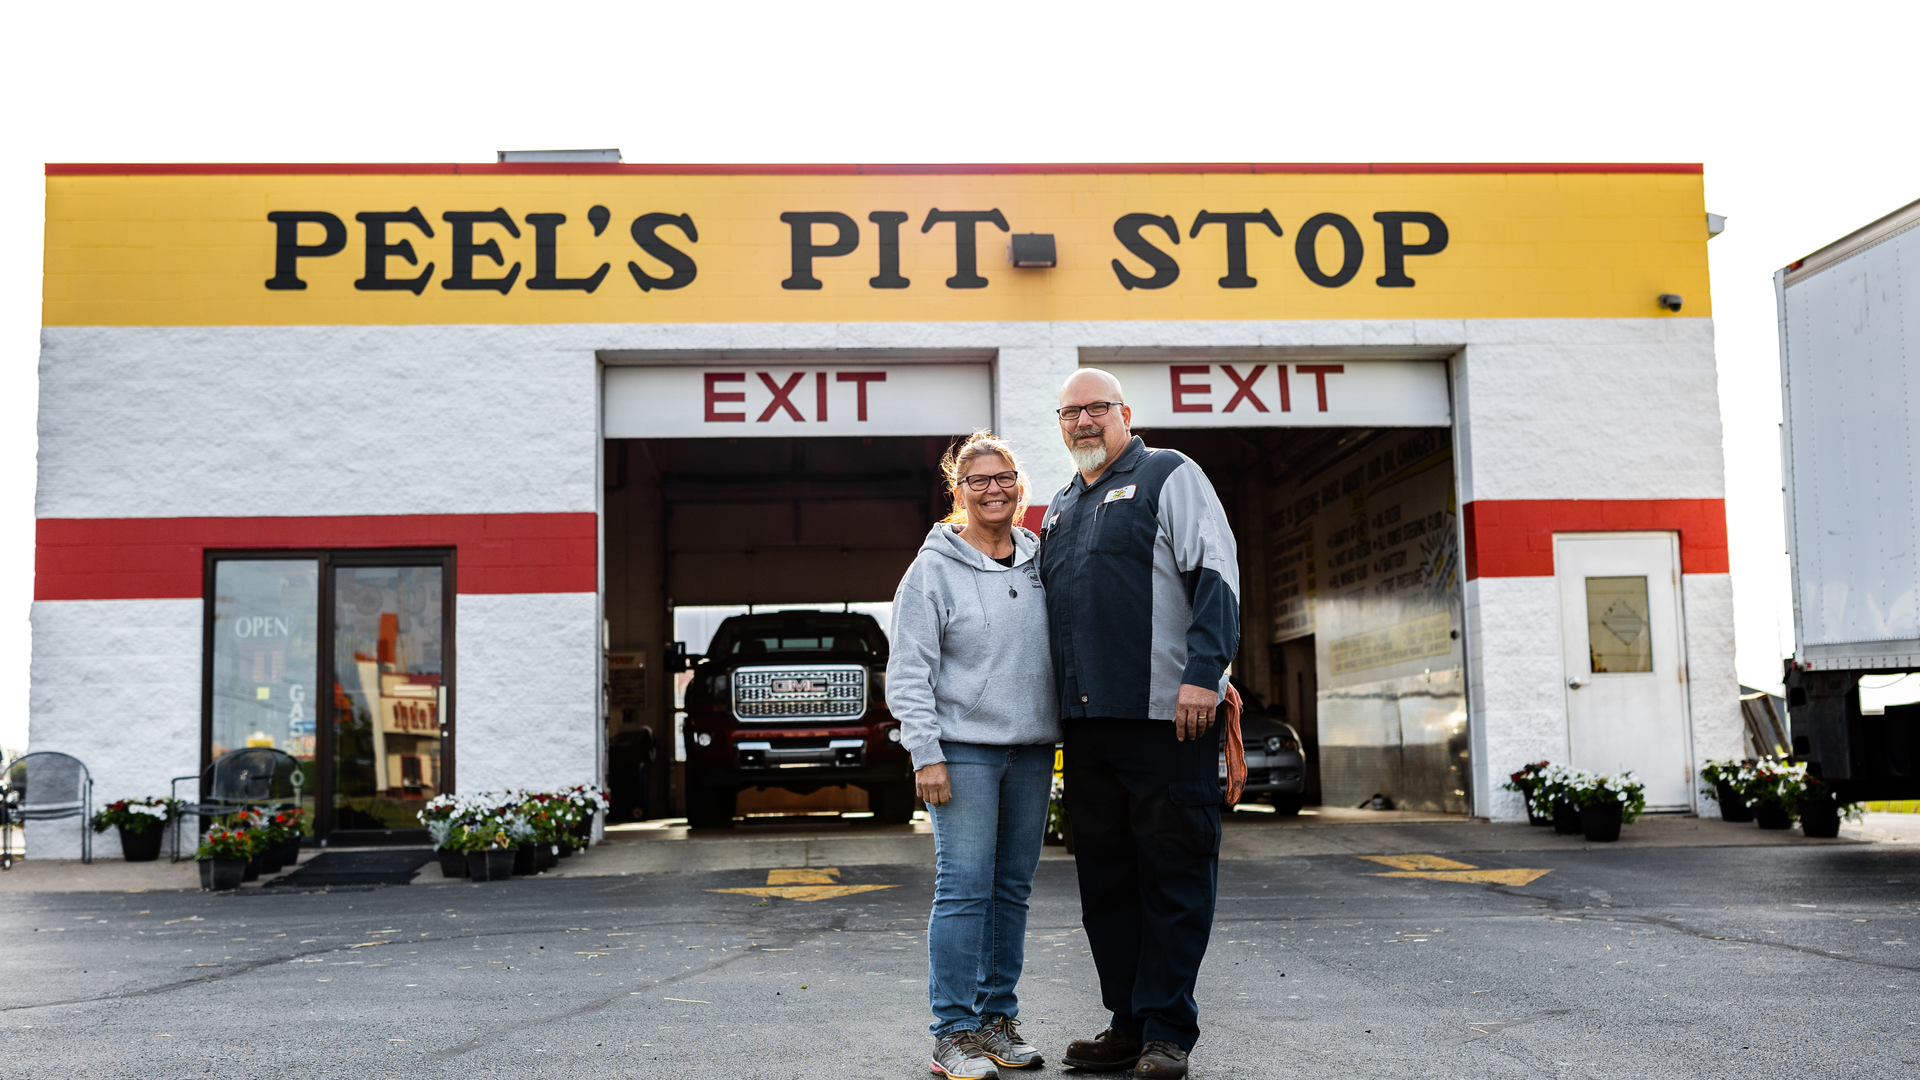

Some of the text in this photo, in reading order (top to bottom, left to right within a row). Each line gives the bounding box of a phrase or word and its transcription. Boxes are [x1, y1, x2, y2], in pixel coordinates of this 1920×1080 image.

[265, 205, 1449, 296] PEEL'S PIT STOP
[704, 371, 887, 422] EXIT
[1169, 364, 1345, 413] EXIT
[235, 616, 289, 638] OPEN
[289, 683, 305, 738] GAS
[772, 679, 826, 692] GMC
